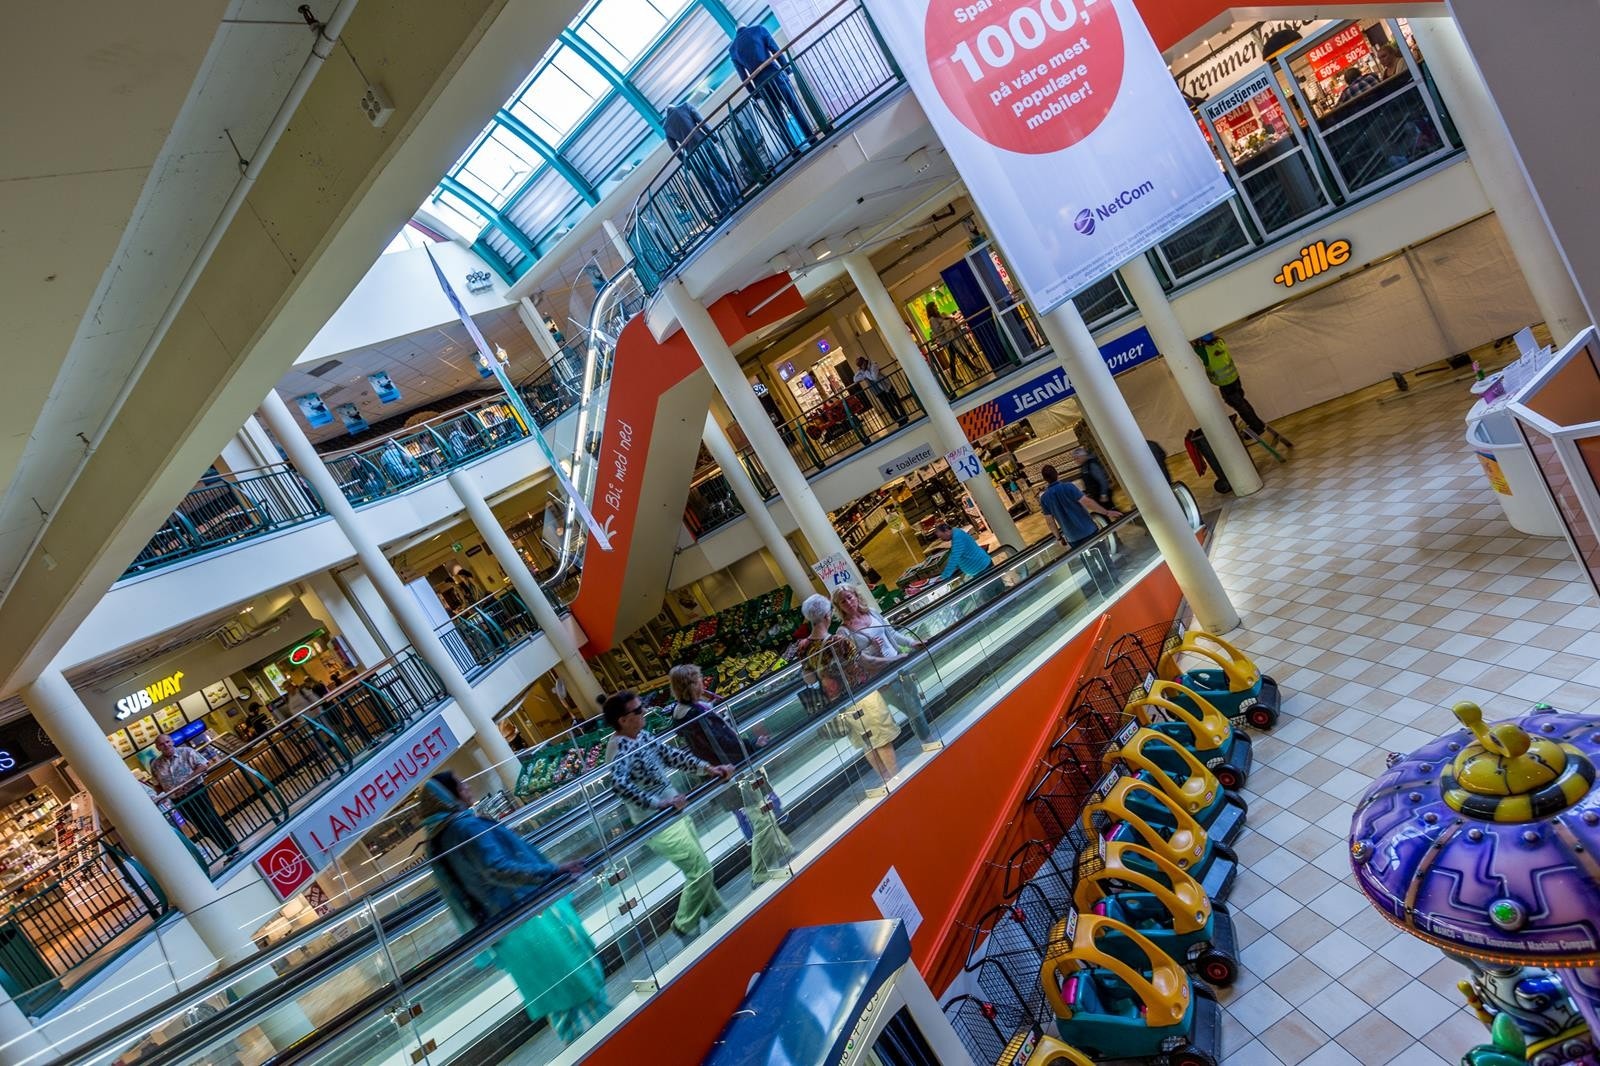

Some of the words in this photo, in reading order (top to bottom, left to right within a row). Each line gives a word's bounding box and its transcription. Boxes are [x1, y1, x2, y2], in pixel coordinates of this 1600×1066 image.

[1309, 43, 1334, 63] SALG
[1335, 25, 1359, 47] SALG
[989, 82, 1013, 106] på
[1011, 62, 1049, 90] våre
[1048, 36, 1092, 70] mest
[1319, 60, 1341, 78] 50%
[1345, 45, 1367, 64] 50%
[1011, 63, 1089, 118] populære
[1026, 80, 1095, 131] mobiler!
[1207, 76, 1270, 121] Kaffestjernen
[1215, 116, 1230, 134] 0%
[1236, 119, 1258, 137] 50%
[1096, 179, 1155, 222] NetCom
[1106, 342, 1145, 370] vner
[617, 418, 633, 452] ned
[612, 449, 629, 483] med
[895, 448, 932, 473] toaletter
[605, 483, 624, 512] Bli
[116, 670, 185, 721] SUBWAY
[309, 726, 448, 855] LAMPEHUSET
[1559, 939, 1596, 951] Company
